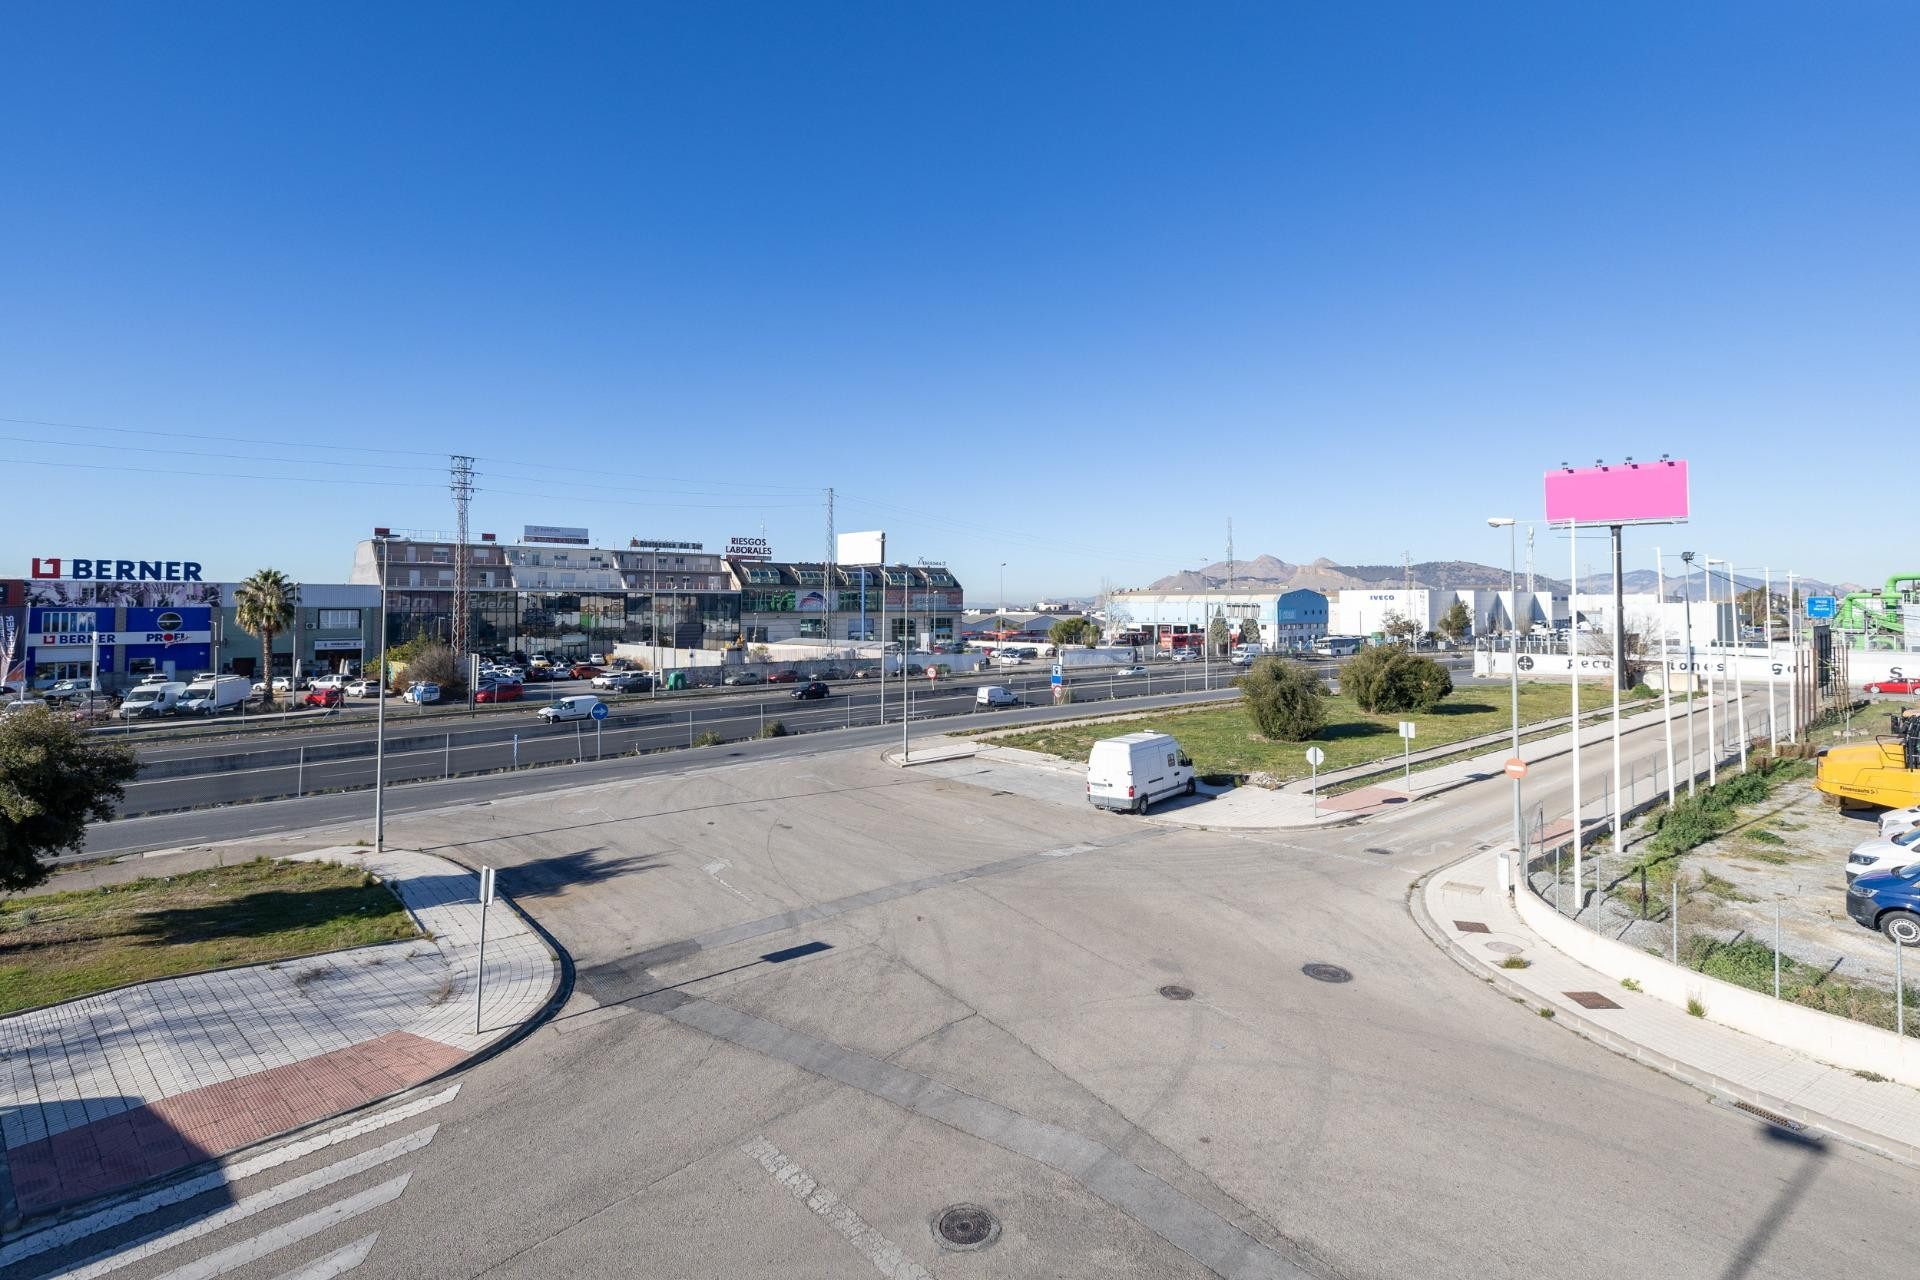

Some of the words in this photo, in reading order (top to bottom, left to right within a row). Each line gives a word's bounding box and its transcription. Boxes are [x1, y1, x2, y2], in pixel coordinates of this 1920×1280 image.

[731, 538, 766, 546] RIESGOS
[725, 546, 772, 554] LABORALES
[73, 559, 203, 581] BERNER
